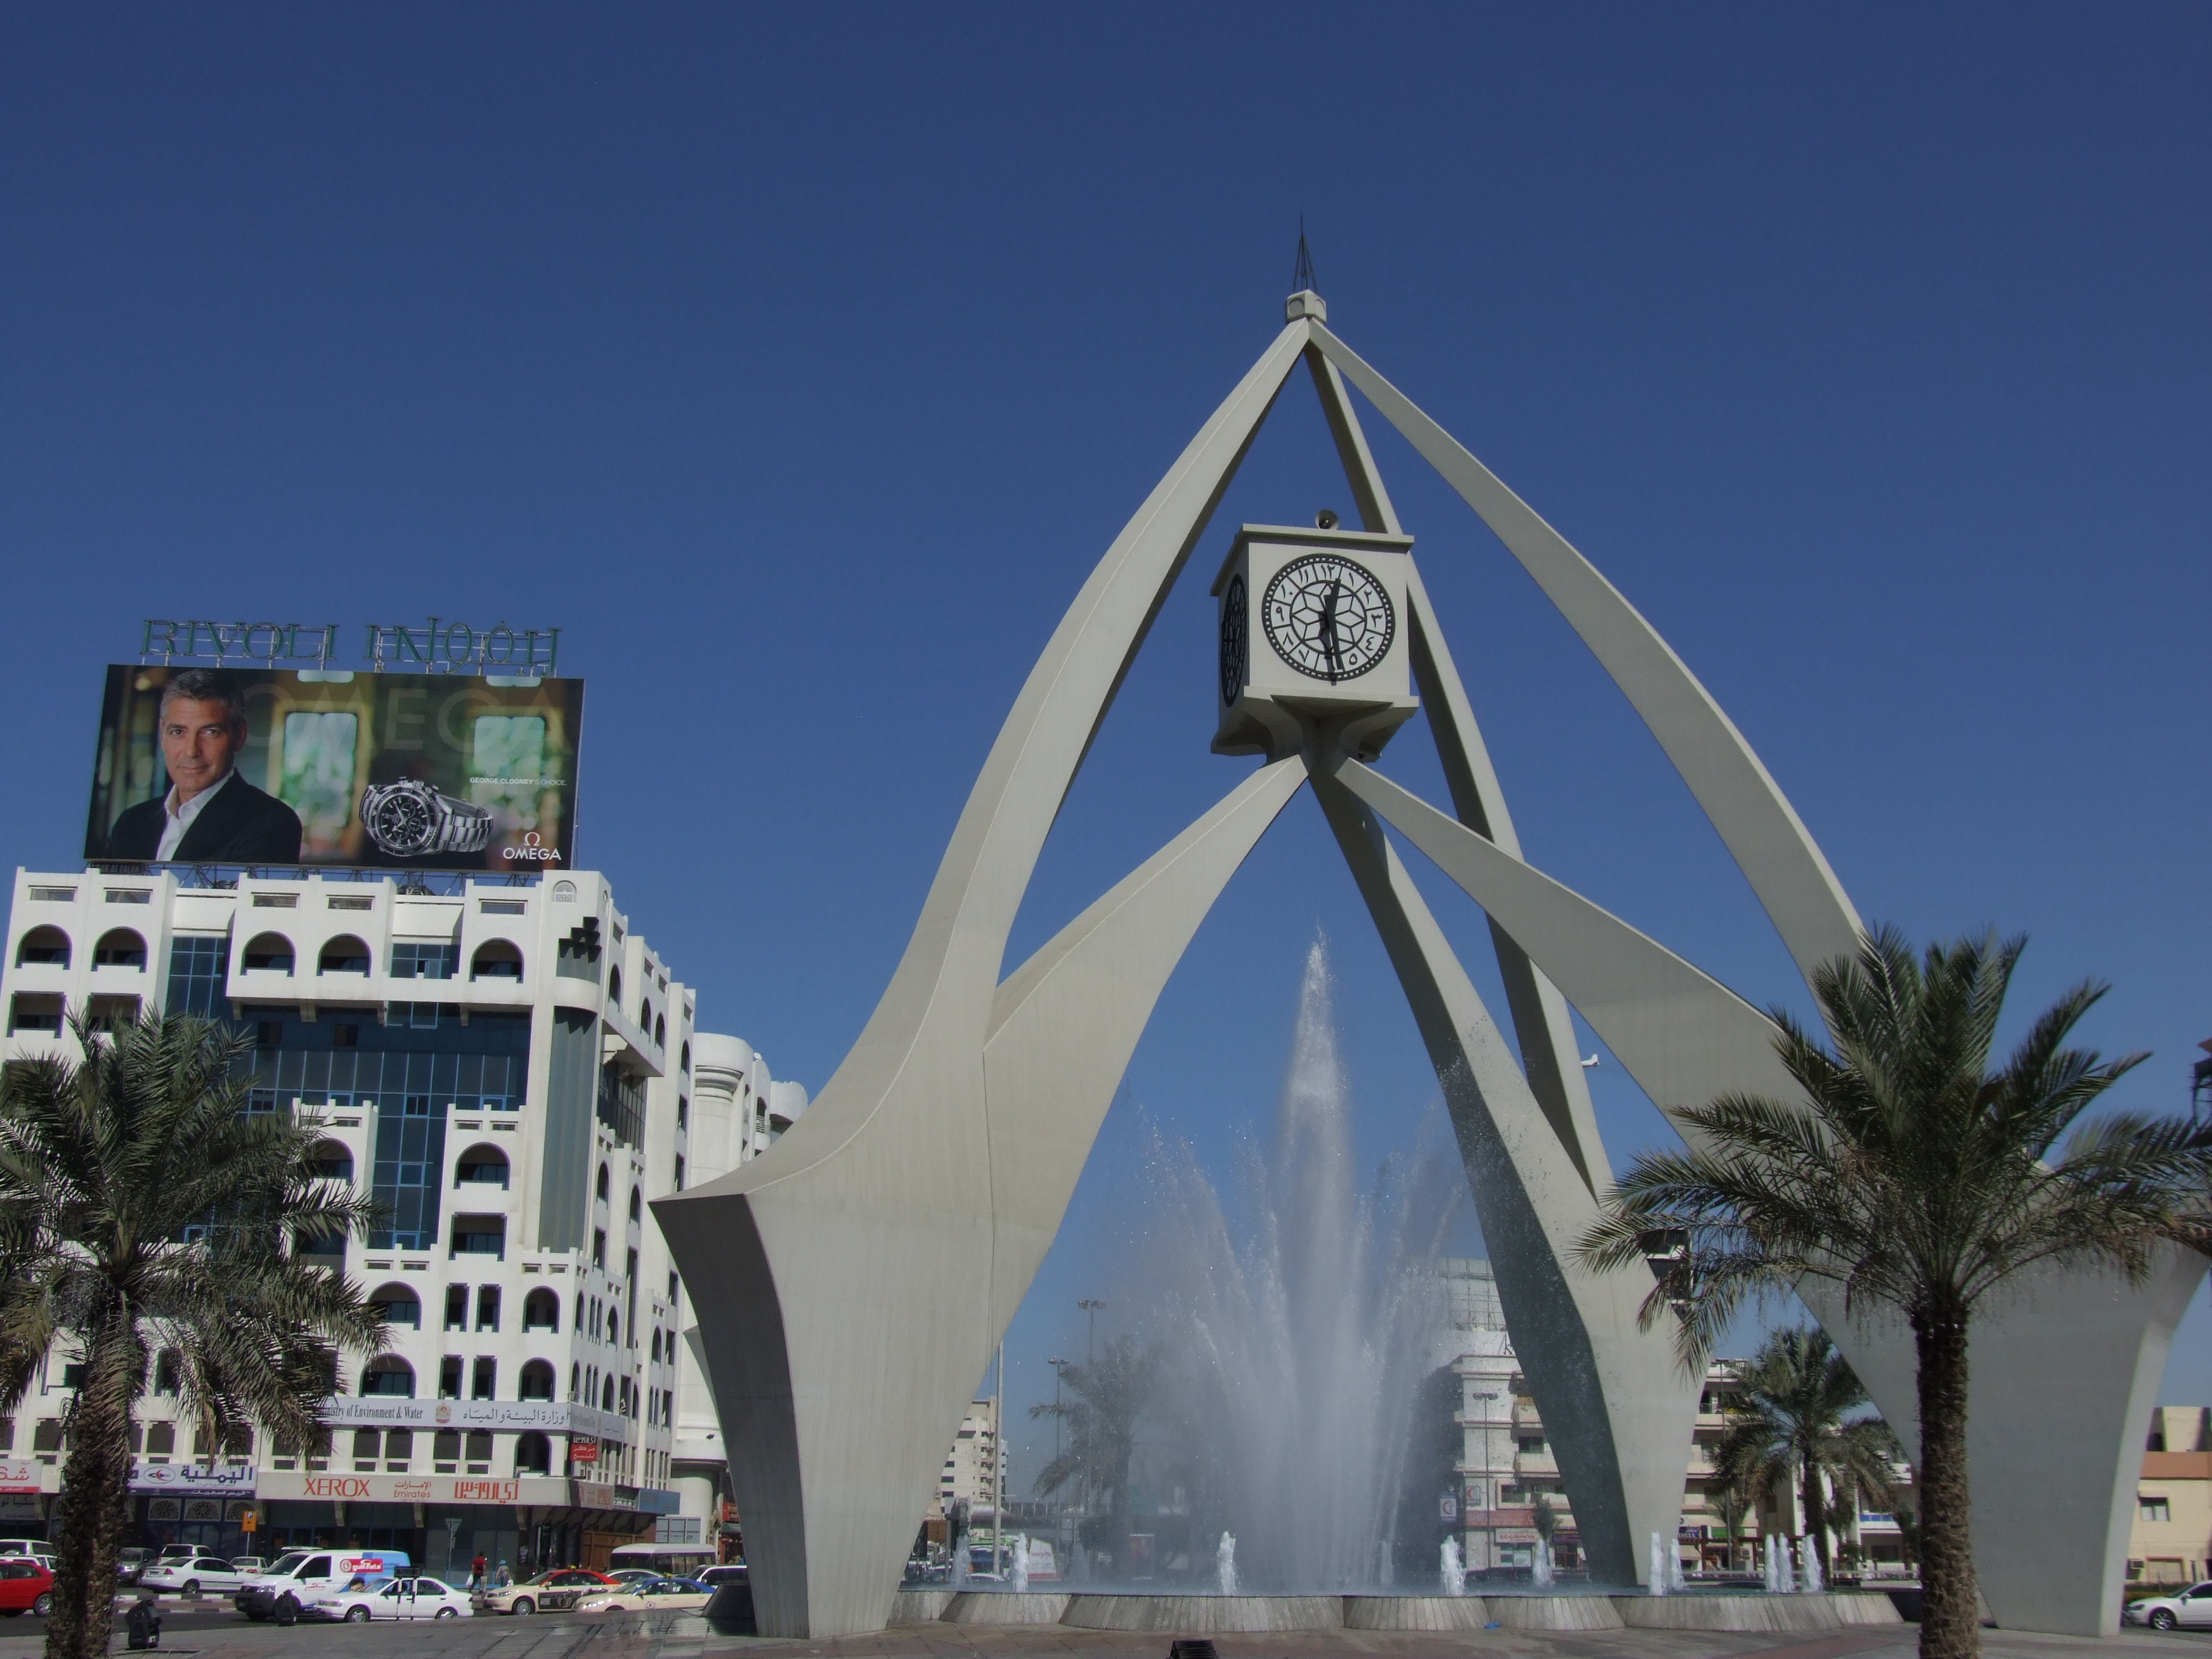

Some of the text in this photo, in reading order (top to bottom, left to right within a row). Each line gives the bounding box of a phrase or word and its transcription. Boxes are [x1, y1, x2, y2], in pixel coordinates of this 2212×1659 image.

[1298, 569, 1309, 584] ١١
[1320, 564, 1336, 579] ١٢
[1348, 571, 1354, 587] ١
[1363, 590, 1372, 604] ٢
[1275, 606, 1284, 622] ٩
[1371, 613, 1383, 628] ٣
[139, 620, 339, 660] RIVOLI
[1282, 631, 1294, 646] ٨
[1365, 636, 1375, 651] ٤
[1298, 649, 1310, 663] ٧
[1348, 653, 1358, 665] ٥
[242, 683, 573, 753] OMEGA
[502, 847, 562, 861] OMEGA
[346, 1405, 354, 1417] of
[355, 1404, 395, 1419] Environment
[396, 1405, 402, 1419] &
[404, 1405, 424, 1419] Water
[542, 1410, 566, 1426] وزارة
[180, 1465, 253, 1483] اليمنية
[304, 1478, 370, 1497] XEROX
[394, 1490, 431, 1498] Emirates
